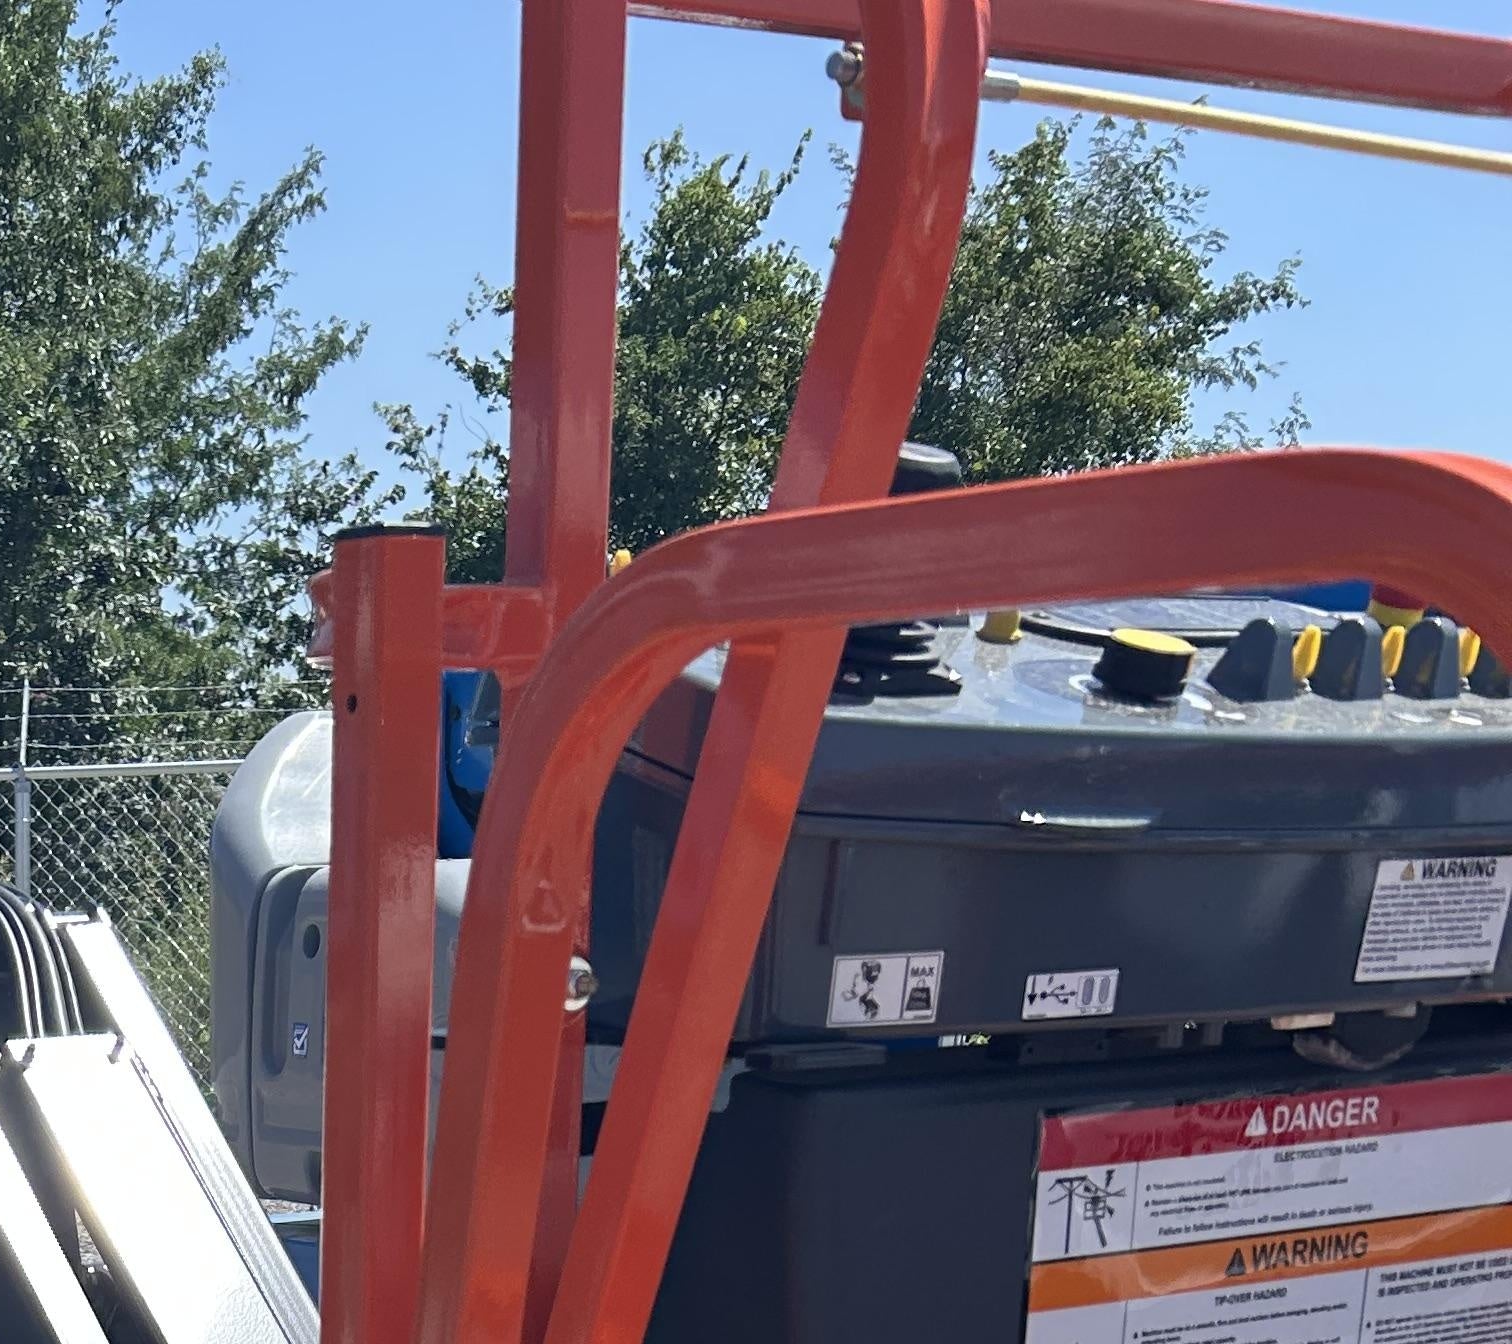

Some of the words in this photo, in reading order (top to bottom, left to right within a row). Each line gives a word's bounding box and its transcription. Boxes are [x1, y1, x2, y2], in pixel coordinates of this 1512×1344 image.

[1422, 858, 1498, 879] WARNING
[910, 966, 935, 978] MAX
[1272, 1096, 1380, 1135] DANGER
[1252, 1231, 1369, 1271] WARNING
